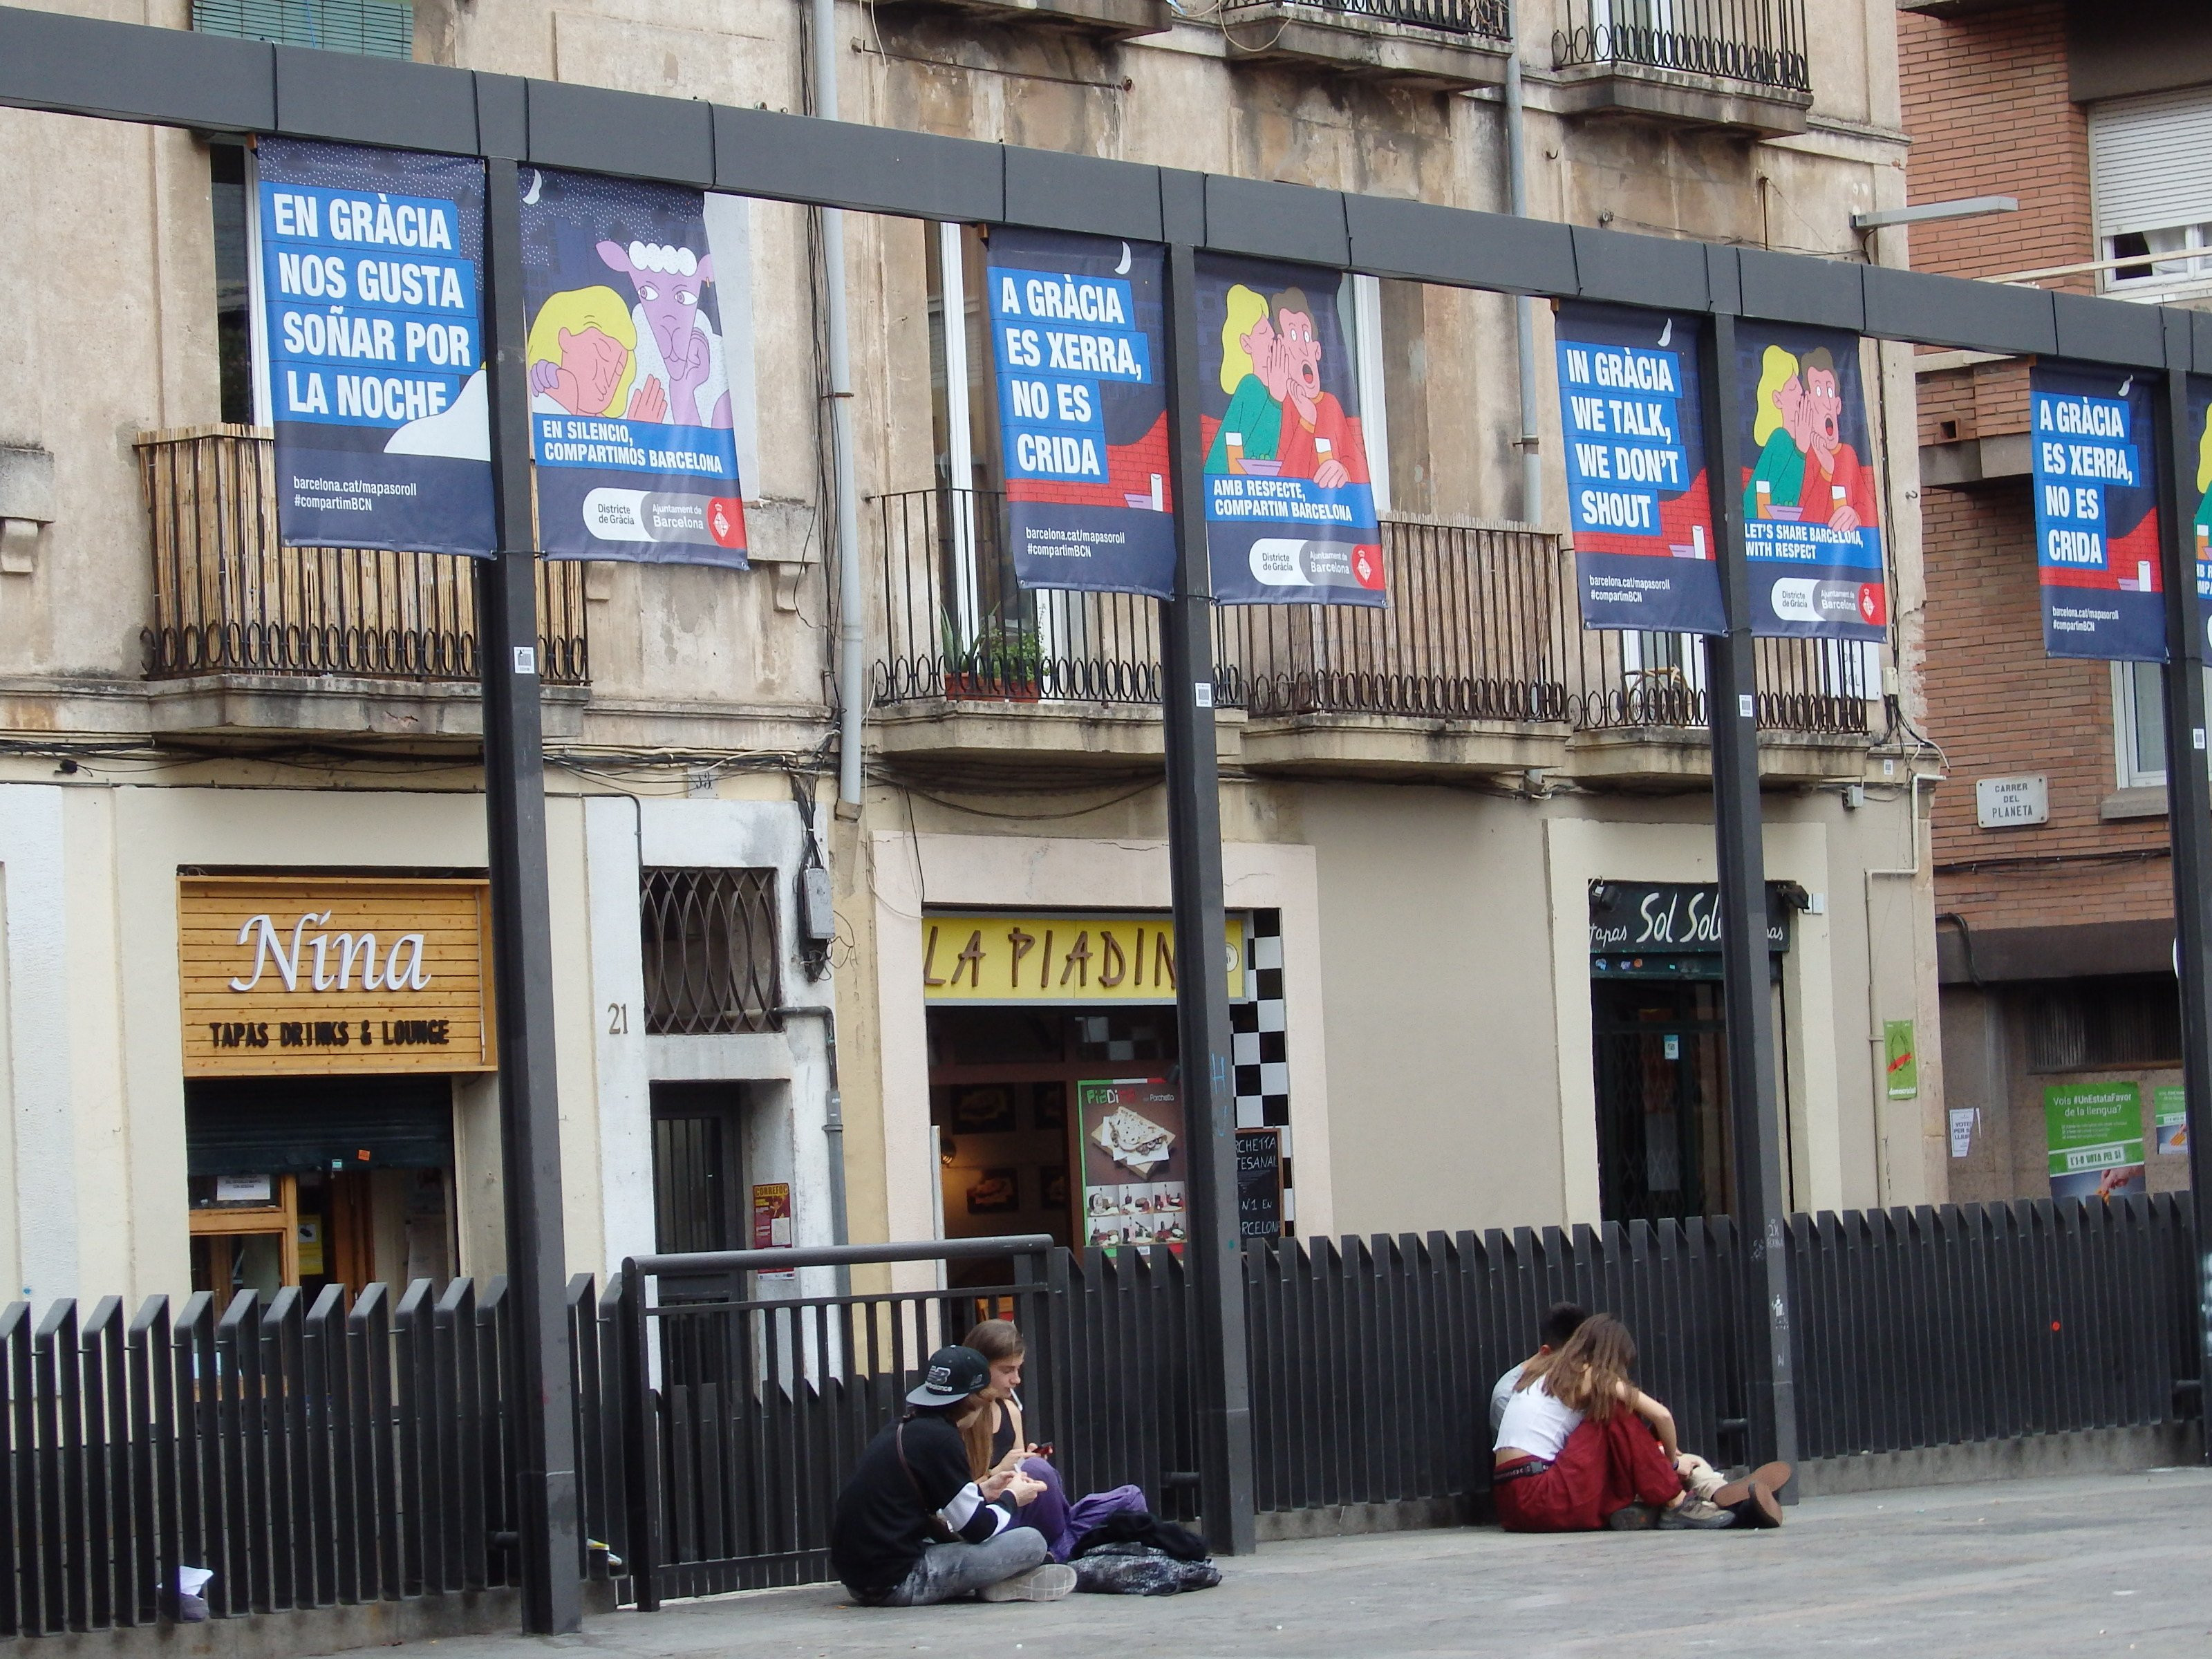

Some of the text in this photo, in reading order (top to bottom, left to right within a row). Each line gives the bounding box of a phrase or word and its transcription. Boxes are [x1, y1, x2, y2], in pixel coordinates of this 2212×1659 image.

[274, 193, 452, 250] EN GRÀCIA
[278, 252, 465, 309] NOS GUSTA
[1002, 274, 1125, 324] A GRÀCIA
[283, 306, 471, 367] SOÑAR POR
[1006, 328, 1142, 381] ES XERRA,
[1566, 347, 1674, 392] IN GRÀCIA
[287, 371, 447, 420] LA NOCHE
[1011, 379, 1091, 423] NO ES
[1571, 395, 1671, 444] WE TALK,
[2040, 396, 2124, 438] A GRÀCIA
[543, 420, 633, 447] EN SILENCIO,
[544, 442, 723, 473] COMPARTIMOS BARCELONA
[1017, 433, 1100, 476] CRIDA
[1575, 442, 1678, 484] WE DON'T
[2042, 442, 2133, 485] ES XERRA,
[294, 476, 417, 496] barcelona.cat/mapasoroll
[1214, 479, 1306, 502] AMB RESPECTE,
[294, 494, 373, 512] #compartimBCN
[597, 503, 630, 514] Districte
[653, 503, 702, 515] Ajuntament de
[1215, 498, 1353, 521] COMPARTIM BARCELONA
[1581, 489, 1651, 528] SHOUT
[2045, 485, 2099, 520] NO ES
[599, 514, 635, 525] de Gràcia
[653, 516, 704, 529] Barcelona
[1026, 527, 1125, 545] barcelona.cat/mapasoroll
[1744, 523, 1864, 548] LET'S SHARE BARCELONA,
[2047, 529, 2102, 564] CRIDA
[1027, 543, 1091, 558] #compartimBCN
[1262, 552, 1290, 562] Districte
[1310, 551, 1342, 561] Ajuntament
[1745, 541, 1816, 559] WITH RESPECT
[1263, 562, 1293, 572] de Gràcia
[1311, 561, 1350, 574] Barcelona
[1589, 574, 1670, 591] barcelona.cat/mapasoroll
[1591, 590, 1642, 603] #compartimBCN
[1782, 590, 1806, 599] Districte
[1782, 599, 1808, 608] de Gràcia
[1821, 598, 1856, 611] Barcelona
[2052, 606, 2119, 621] barcelona.cat/mapasoroll
[1995, 783, 2028, 793] CARRER
[2003, 795, 2020, 803] DEL
[1992, 805, 2033, 818] PLANETA
[1635, 892, 1678, 943] Sol
[228, 908, 431, 992] Nina
[924, 926, 987, 987] LA
[608, 1002, 628, 1034] 21
[209, 1020, 450, 1048] TAPAS DRINKS & LOUNGE
[2053, 1097, 2072, 1106] Vols
[2064, 1105, 2122, 1117] de la llengua?
[755, 1184, 788, 1197] CORREFOC
